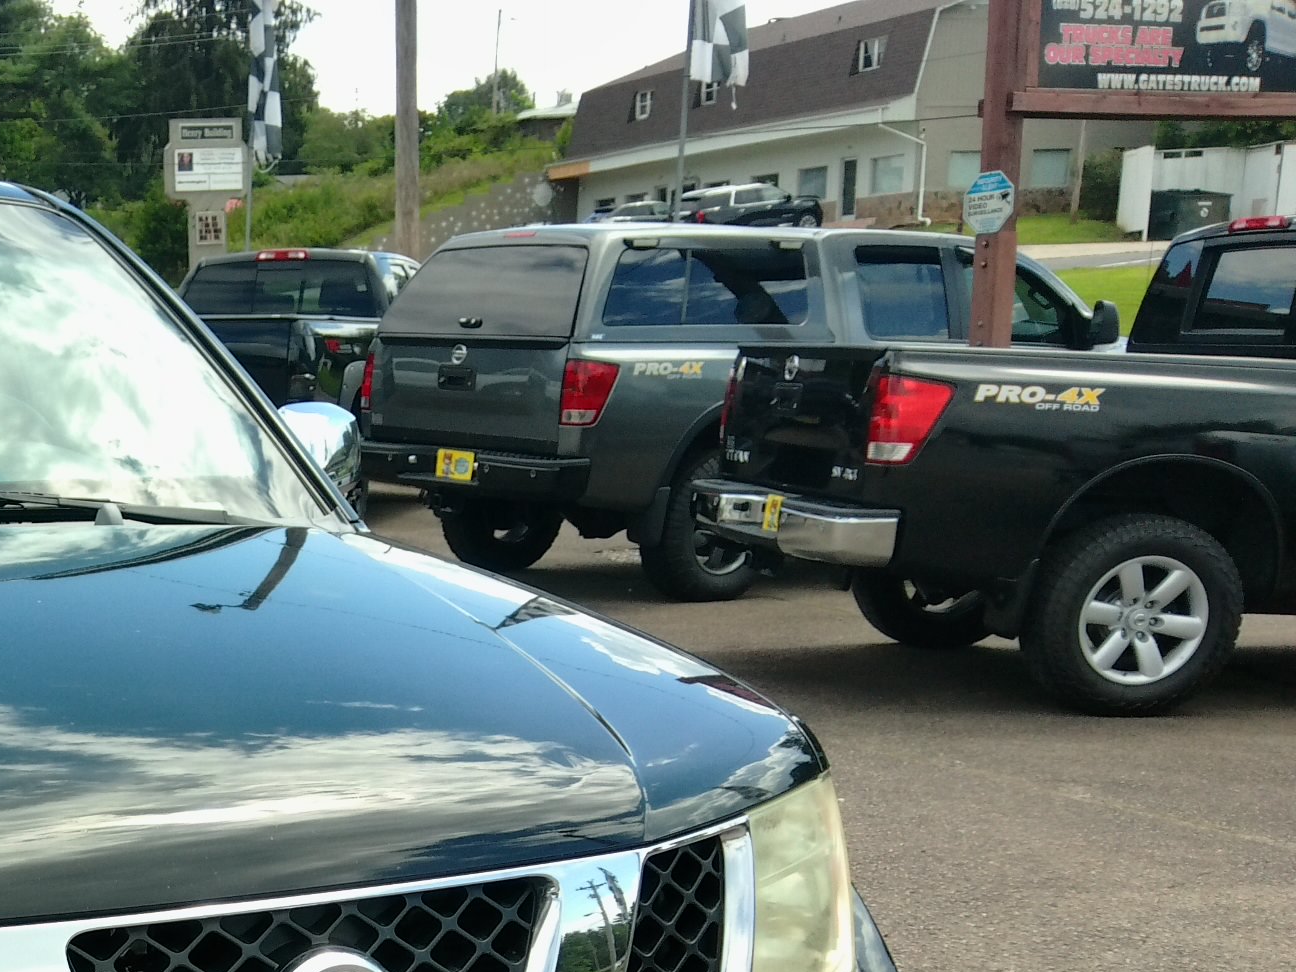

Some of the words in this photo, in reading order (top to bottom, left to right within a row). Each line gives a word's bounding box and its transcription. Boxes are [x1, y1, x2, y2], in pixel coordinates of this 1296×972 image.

[1060, 23, 1133, 45] TRUCKS
[1134, 26, 1173, 47] ARE
[1045, 43, 1086, 65] OUR
[1088, 46, 1184, 67] SPECIALTY
[1097, 73, 1261, 92] WWW.GATESTRUCK.COM
[632, 361, 704, 376] PRO-4X
[974, 383, 1106, 405] PRO-4X
[1035, 402, 1061, 411] OFF
[1063, 403, 1100, 412] ROAD
